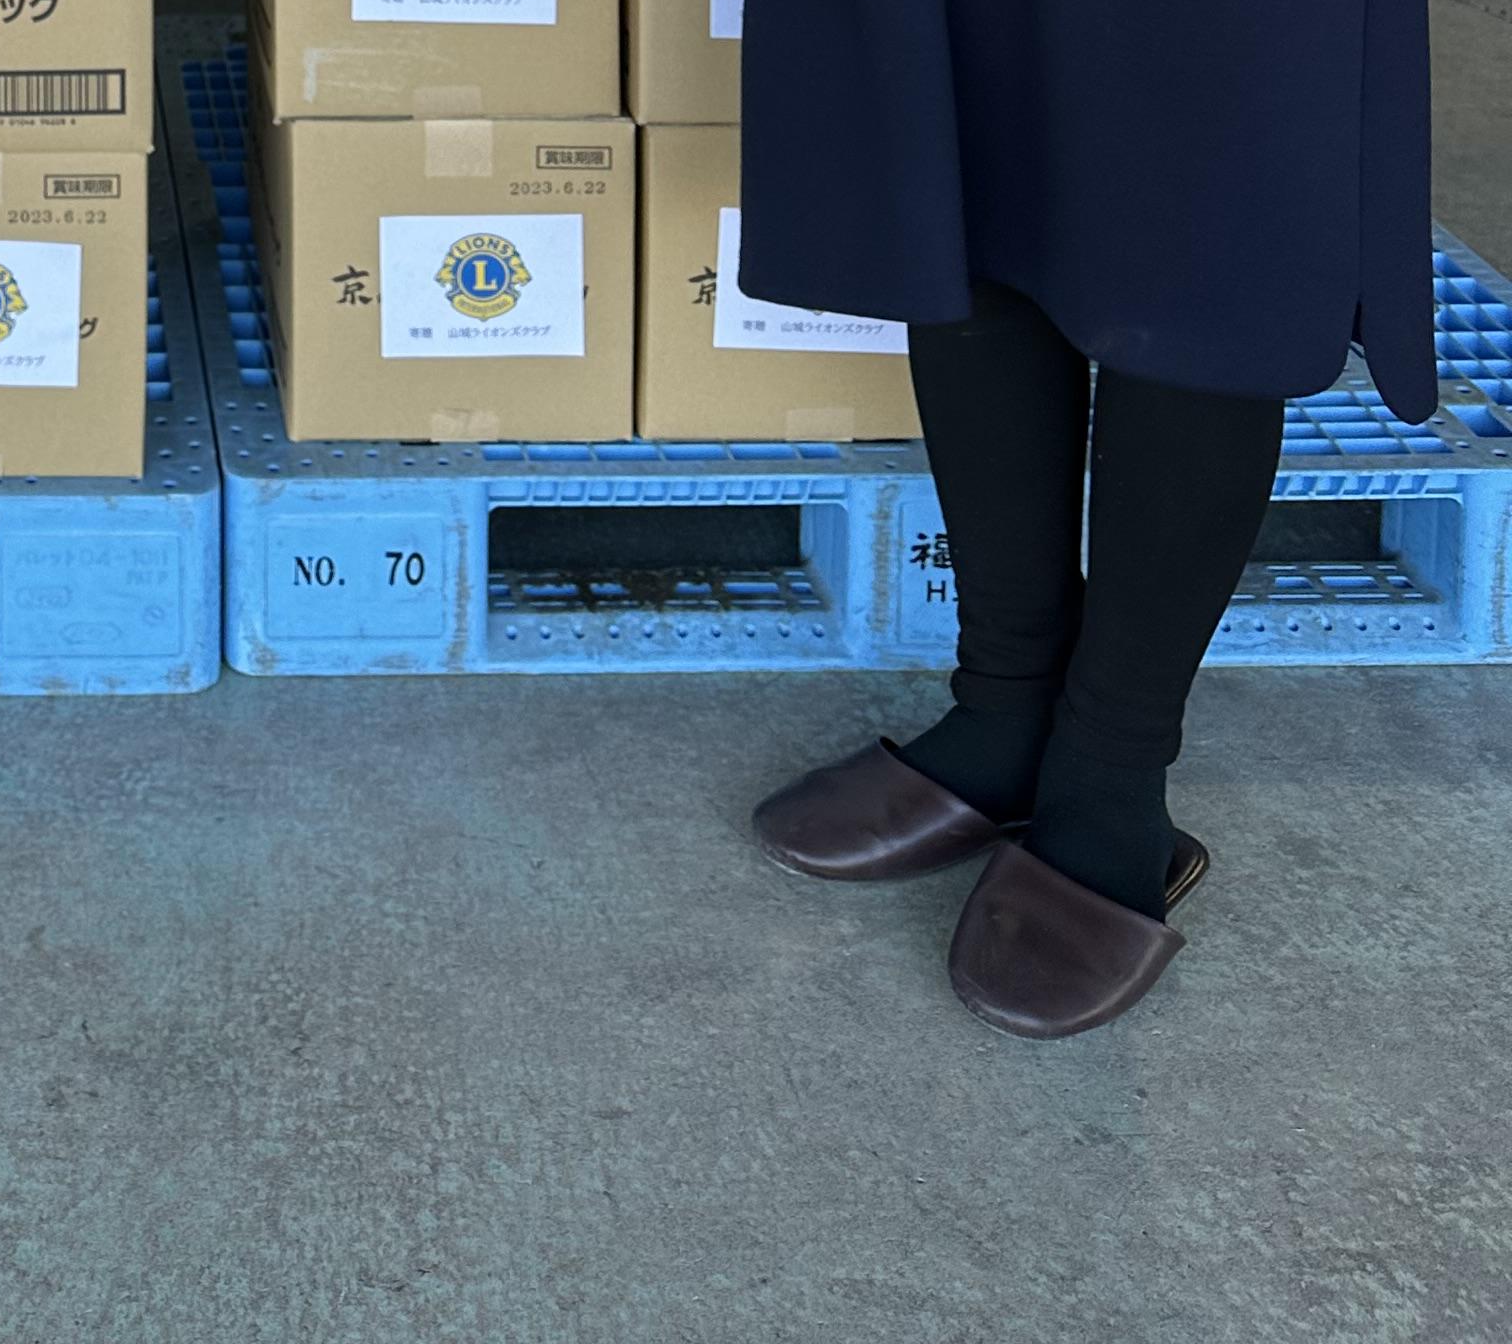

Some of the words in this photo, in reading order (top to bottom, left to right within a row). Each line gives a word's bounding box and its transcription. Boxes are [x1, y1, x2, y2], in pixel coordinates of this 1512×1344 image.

[509, 181, 607, 196] 2023.6.22
[7, 210, 108, 225] 2023.6.22
[456, 237, 510, 256] LIONS
[471, 260, 499, 291] L
[294, 556, 345, 586] NO.
[386, 552, 425, 586] 70
